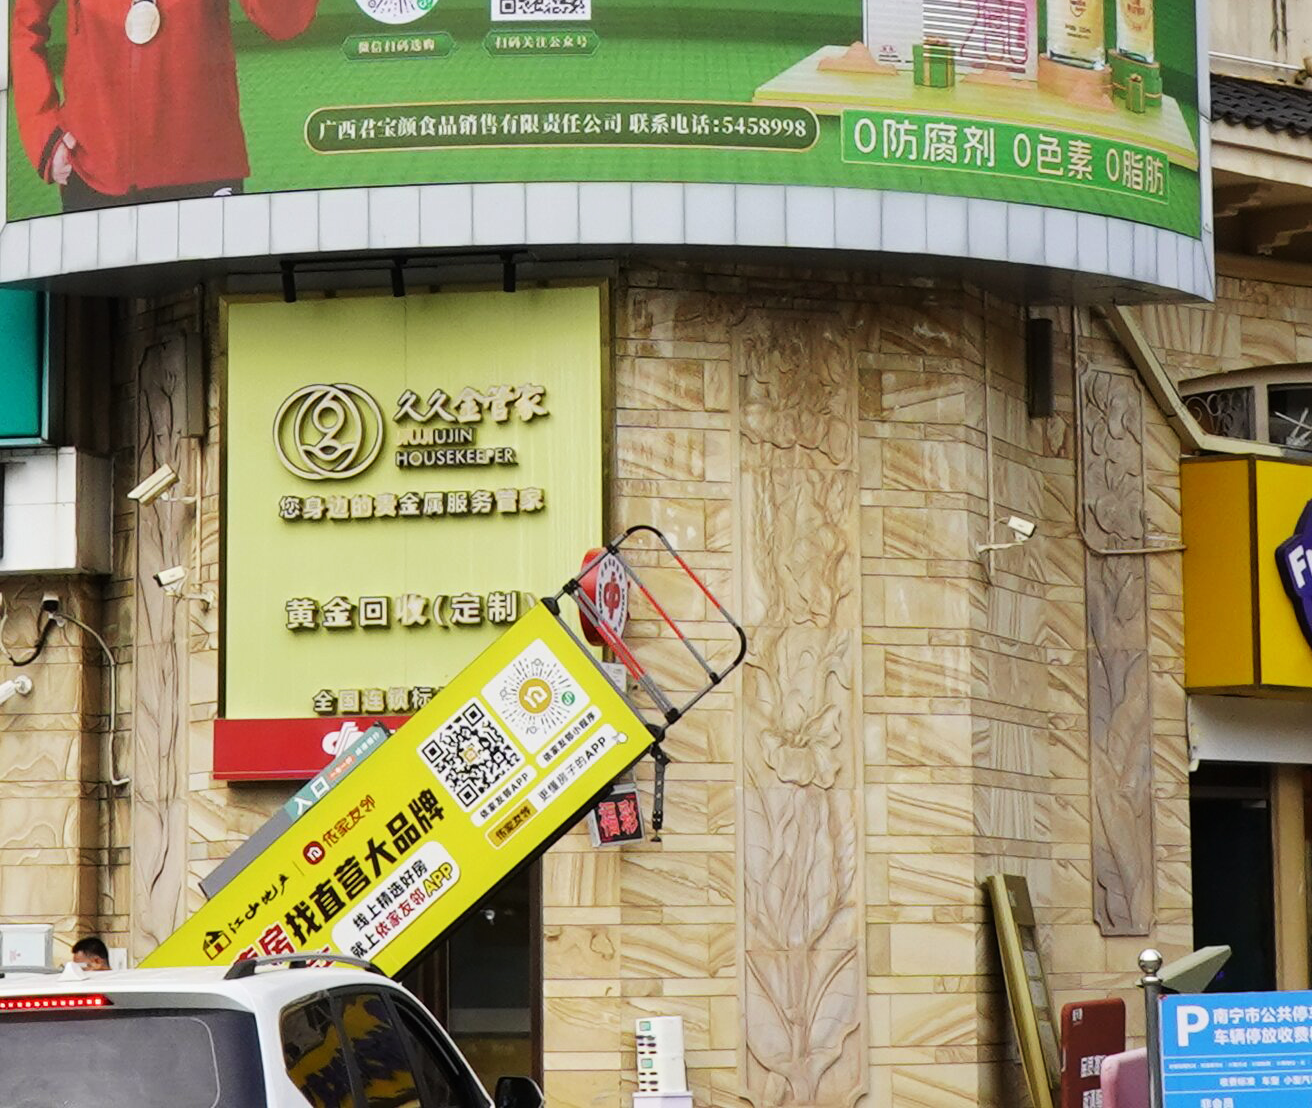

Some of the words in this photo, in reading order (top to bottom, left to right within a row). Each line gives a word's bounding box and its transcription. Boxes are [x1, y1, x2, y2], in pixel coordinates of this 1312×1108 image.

[854, 118, 996, 168] 0防腐剂
[1013, 133, 1094, 182] 0色素
[1105, 148, 1165, 197] 0脂肪
[394, 382, 551, 424] 久久金管家
[395, 448, 515, 467] HOUSEKEEPER
[279, 487, 545, 520] 您身边的贵金属服务管家
[312, 687, 445, 715] 全国连锁标
[294, 776, 330, 816] 入口
[352, 859, 428, 932] 线上精选好房
[1176, 1005, 1210, 1047] P
